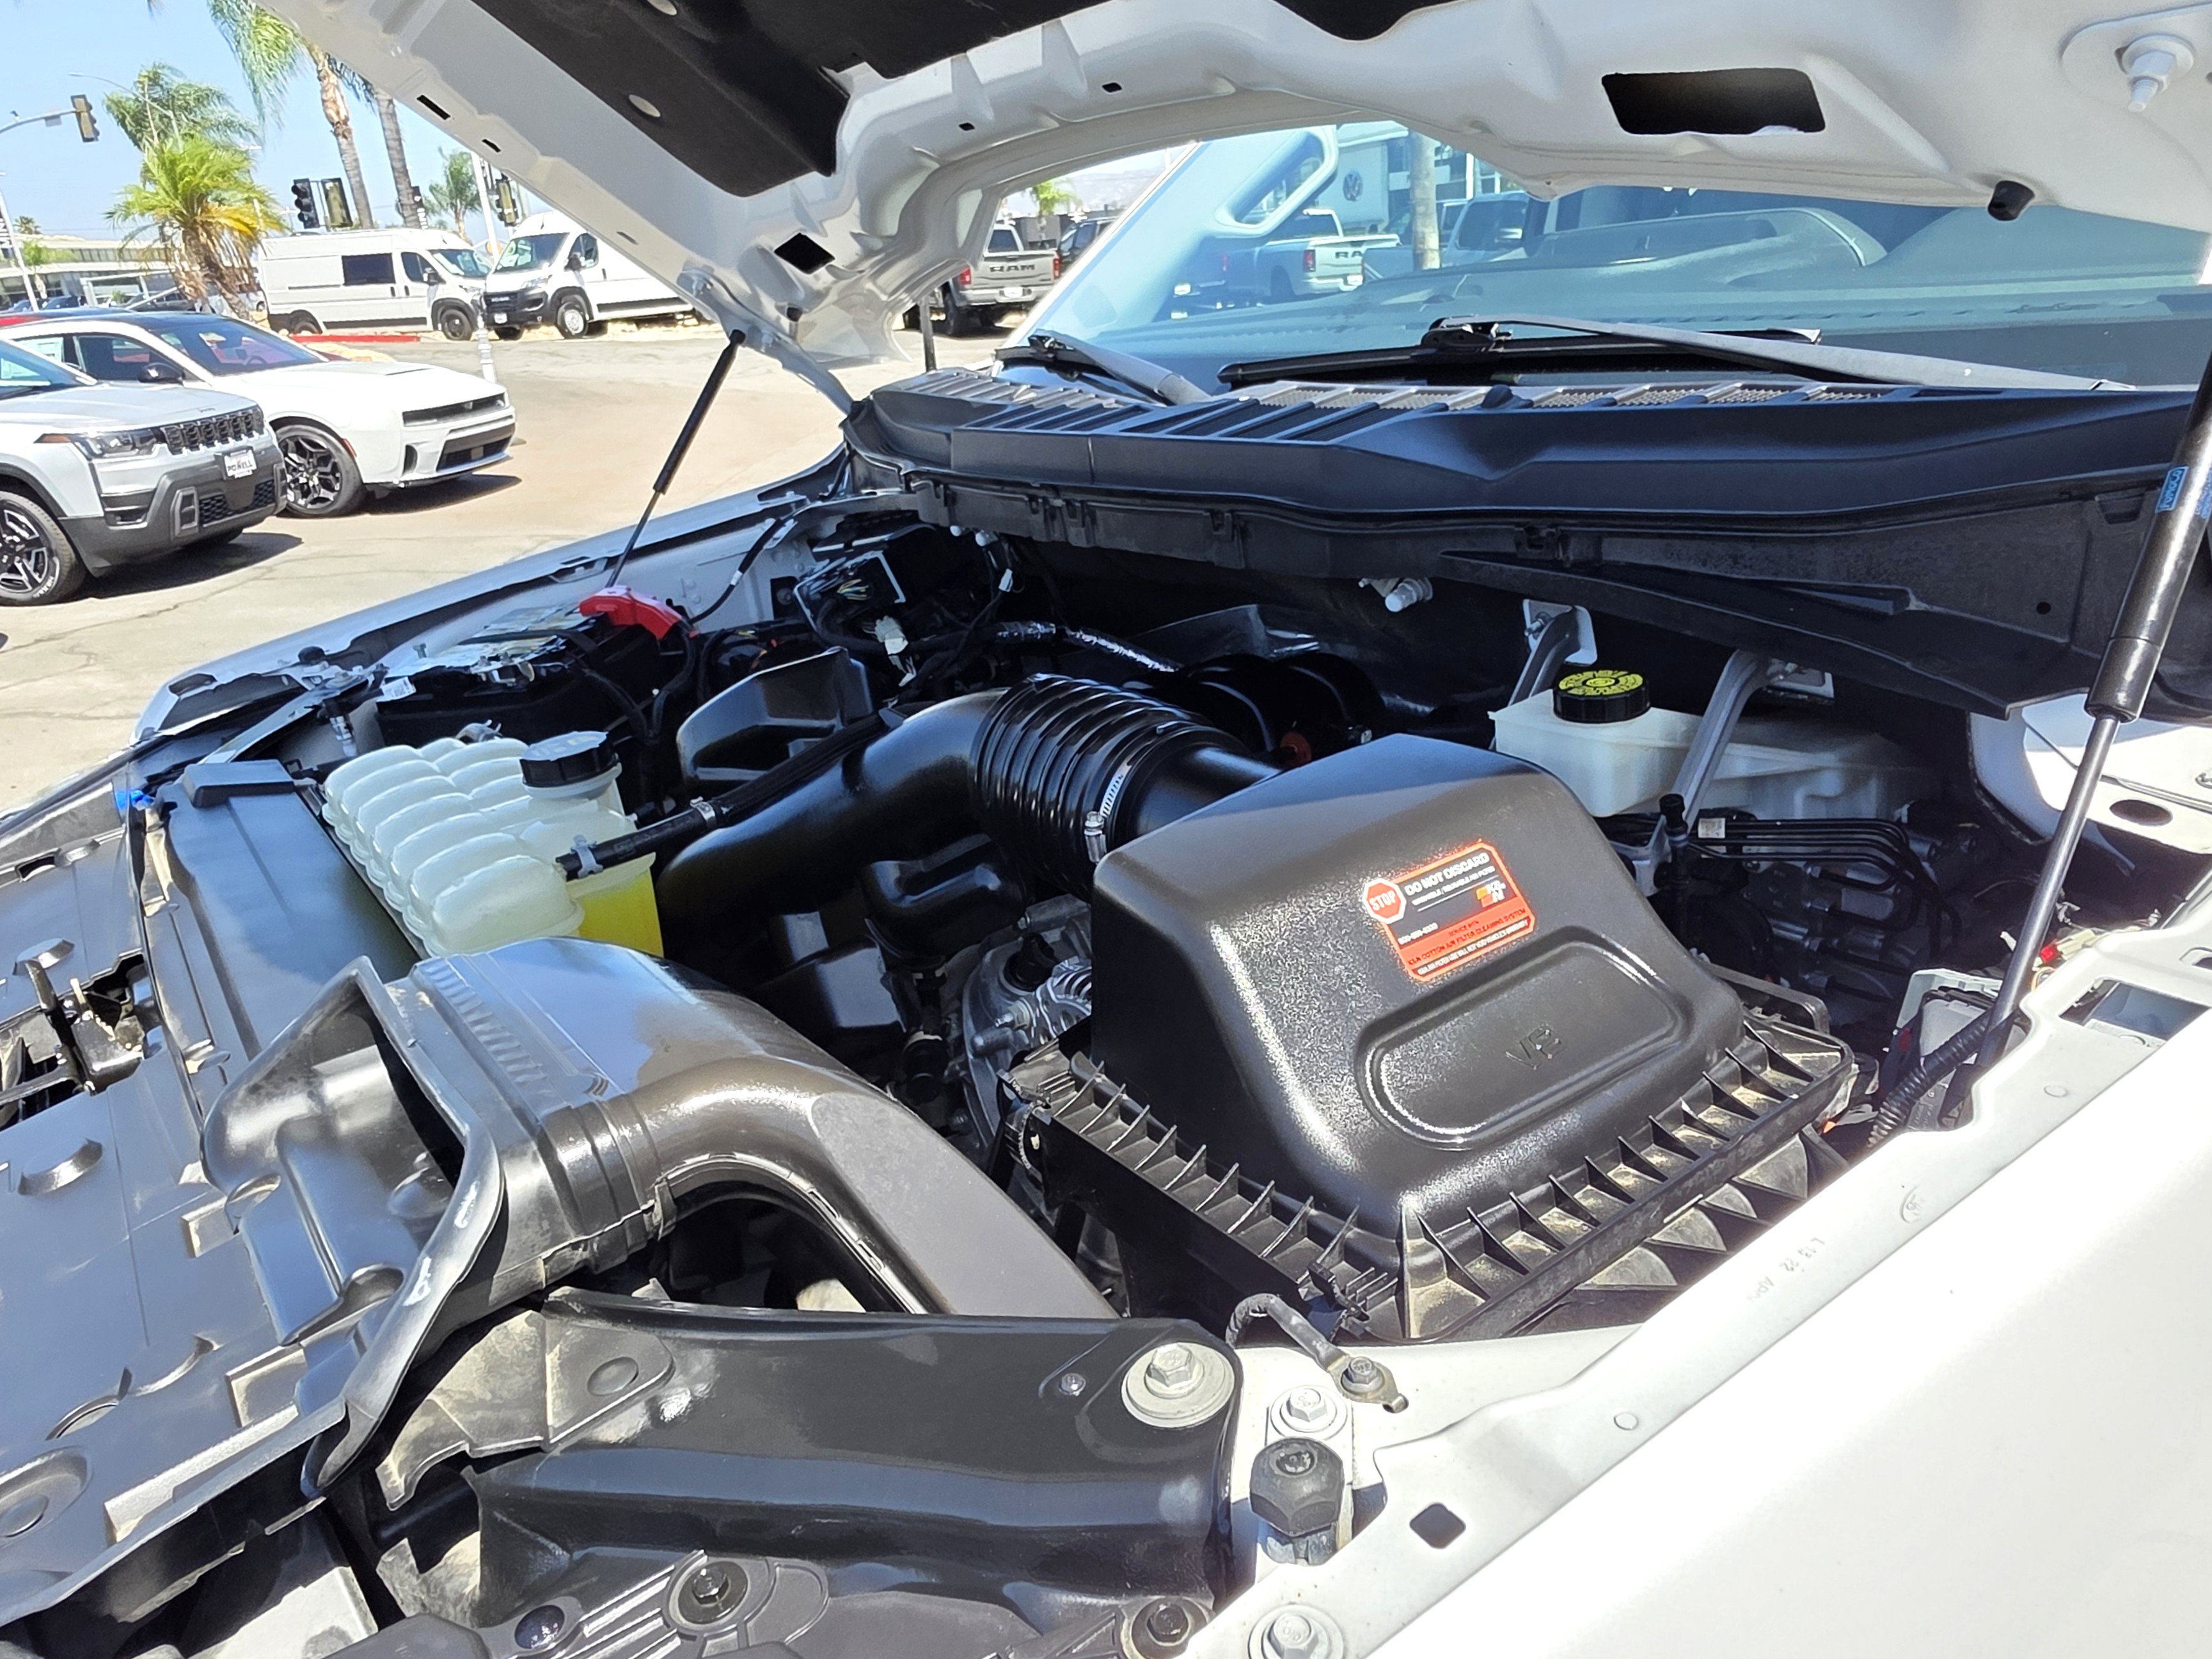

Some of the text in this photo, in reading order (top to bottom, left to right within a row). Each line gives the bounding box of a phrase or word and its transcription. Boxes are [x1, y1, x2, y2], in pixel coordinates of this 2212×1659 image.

[1335, 250, 1363, 259] RA
[989, 264, 1036, 273] RAM
[1404, 881, 1423, 896] DO
[1421, 871, 1444, 889] NOT
[1442, 852, 1490, 879] DISCARD
[1370, 889, 1396, 911] STOP
[1421, 946, 1446, 960] COTTON
